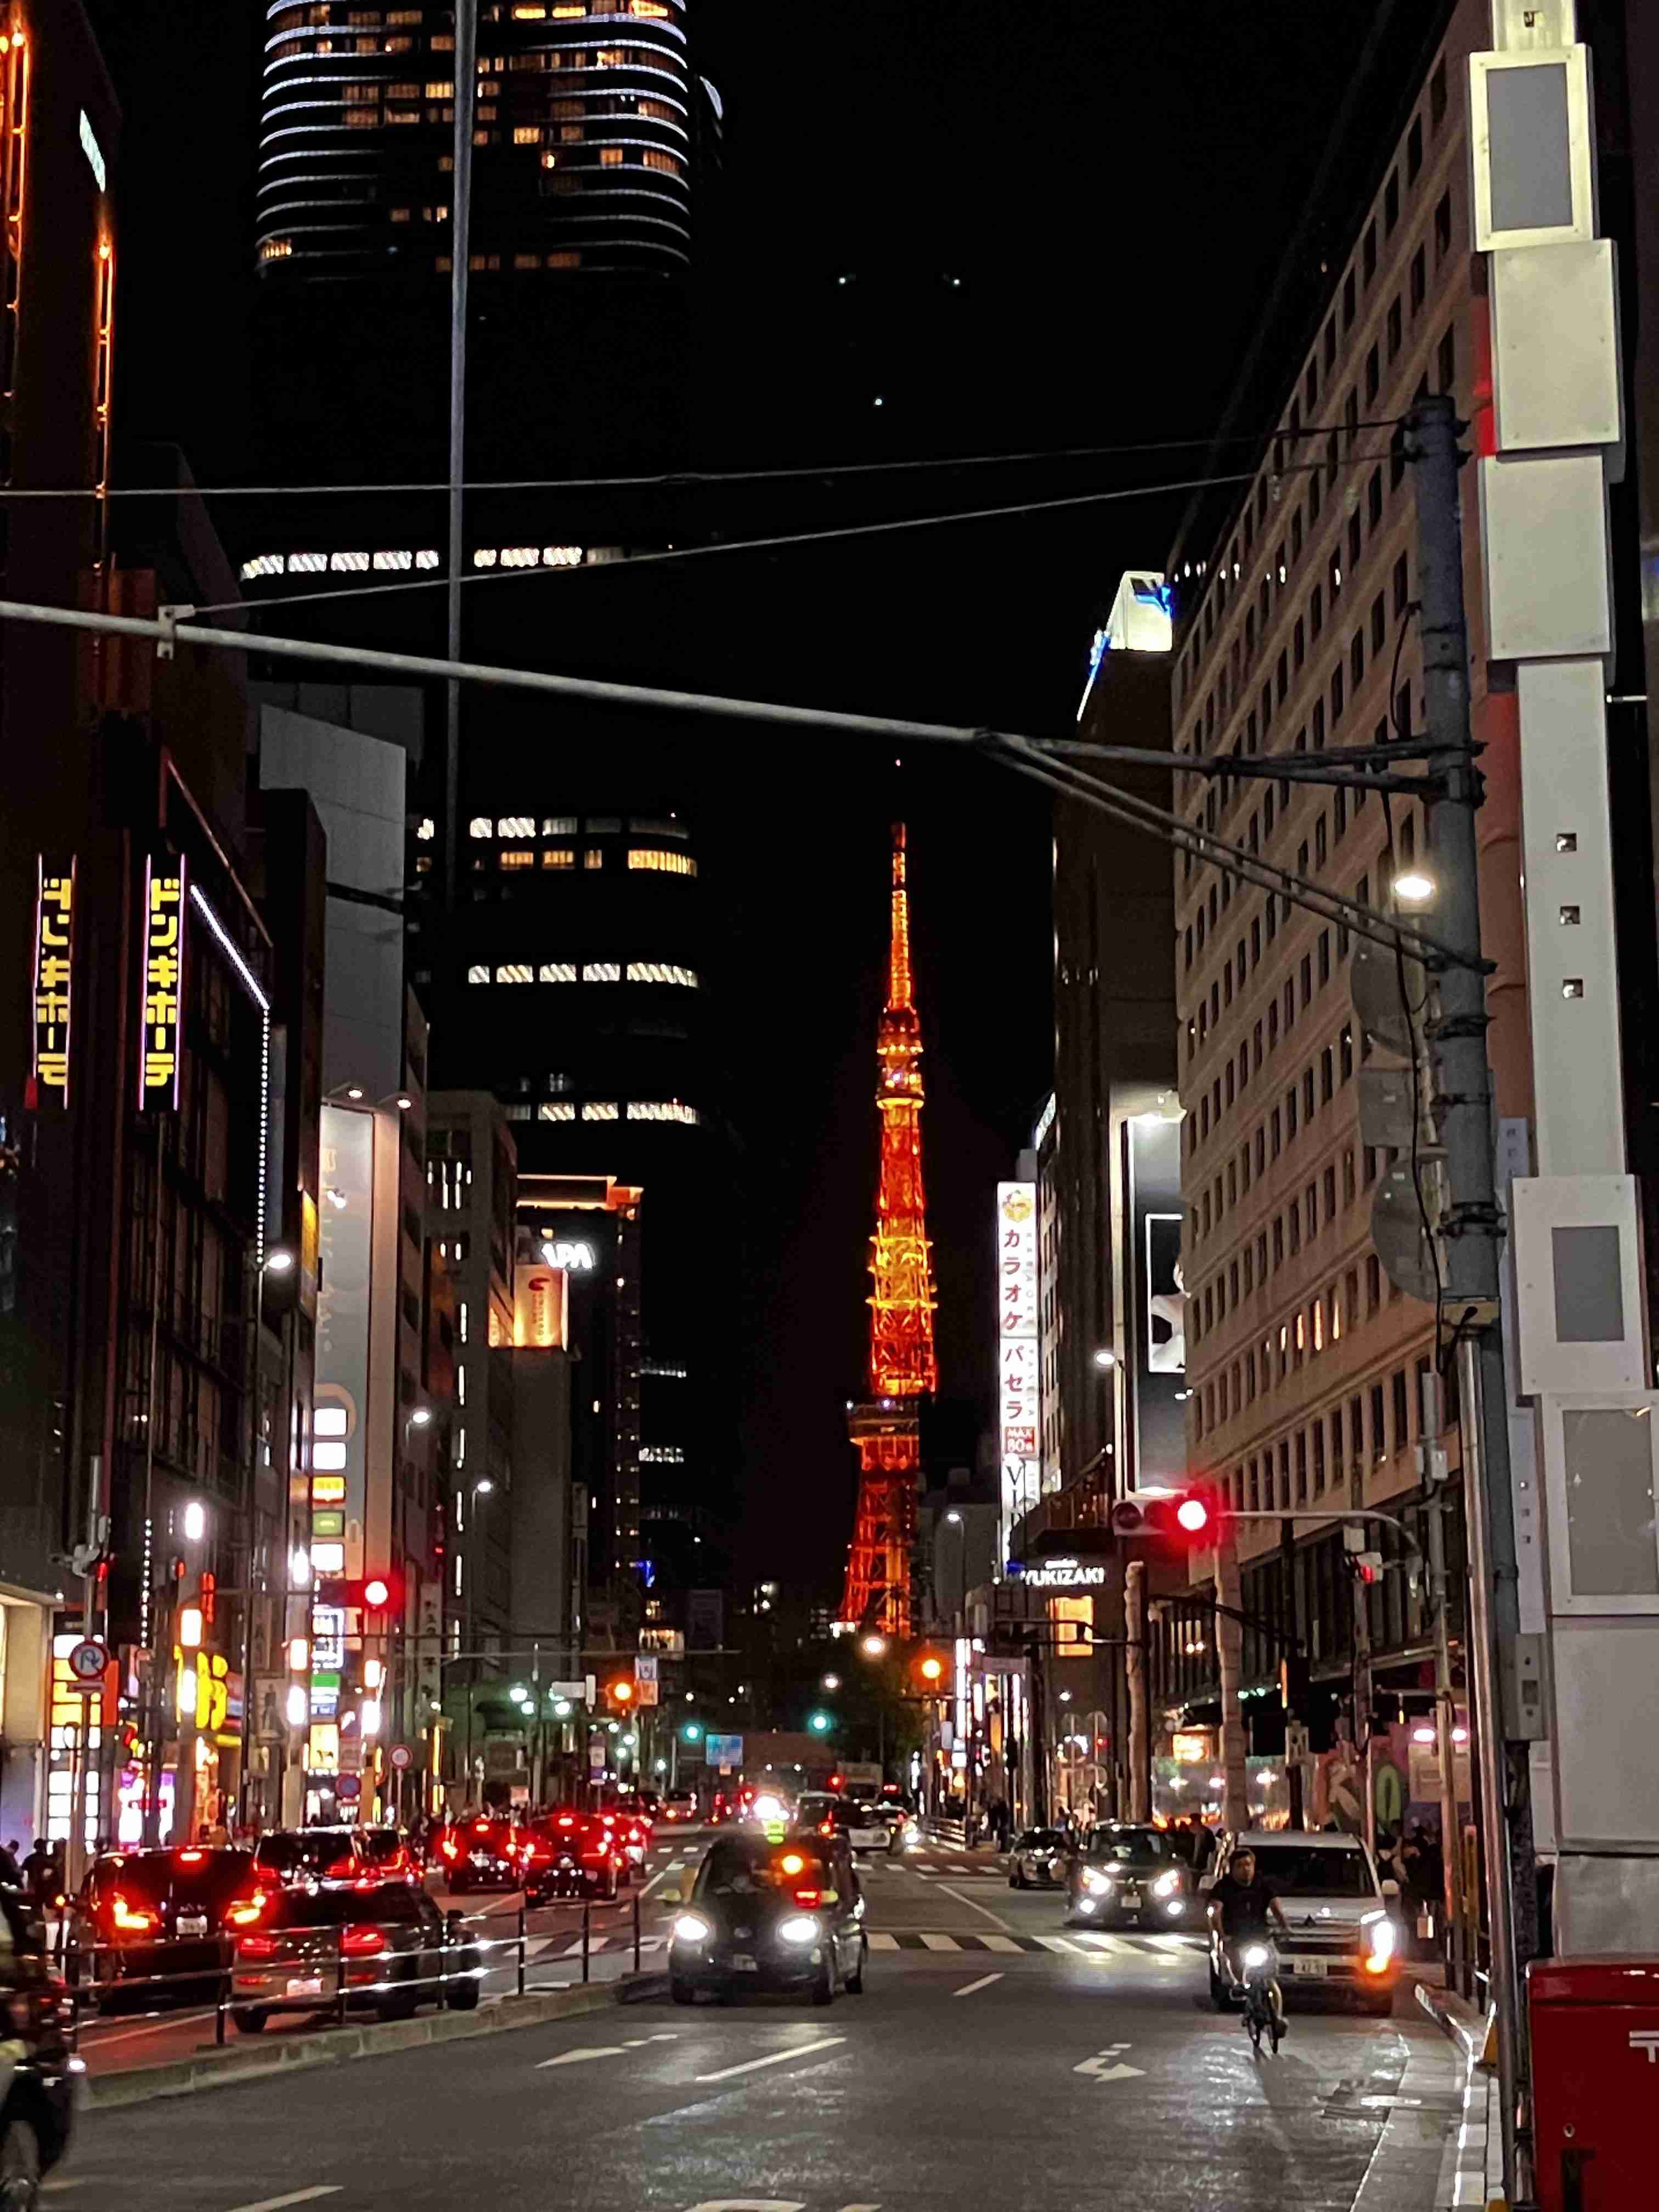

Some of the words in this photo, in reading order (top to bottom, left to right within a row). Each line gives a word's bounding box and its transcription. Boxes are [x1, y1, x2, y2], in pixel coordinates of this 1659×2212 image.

[1003, 1229, 1023, 1330] カラオケ
[1004, 1345, 1024, 1419] パセラ
[1020, 1567, 1105, 1586] YUKIZAKI
